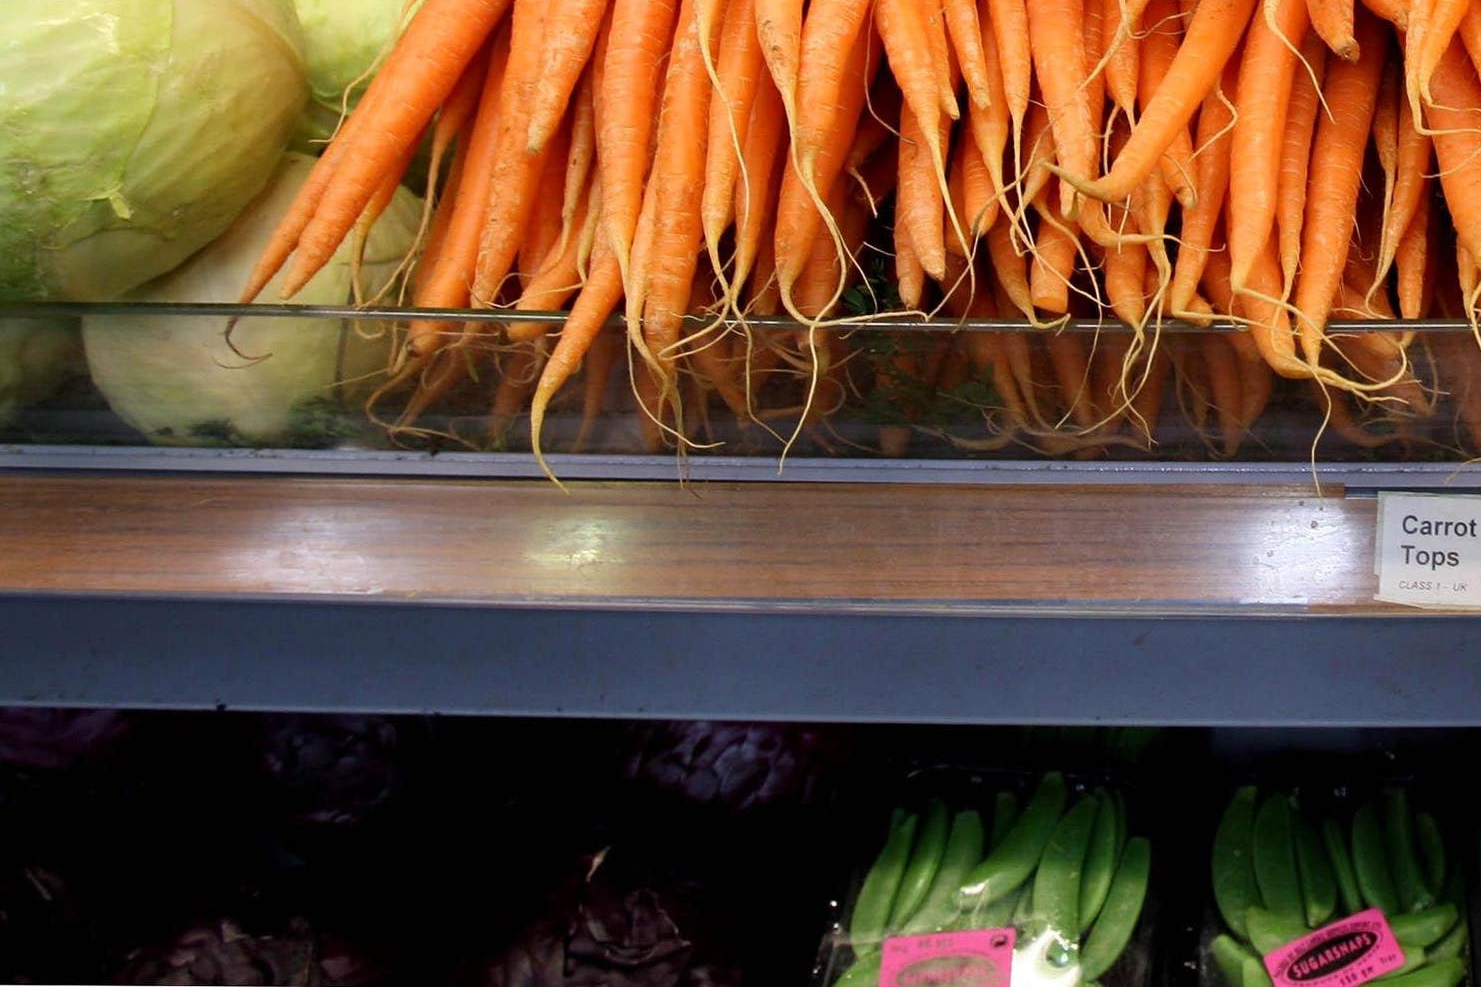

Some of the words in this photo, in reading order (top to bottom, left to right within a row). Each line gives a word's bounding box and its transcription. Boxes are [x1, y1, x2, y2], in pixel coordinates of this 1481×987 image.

[1402, 515, 1477, 538] Carrot
[1400, 544, 1460, 570] Tops
[1399, 580, 1433, 591] CLASS
[1453, 582, 1468, 592] UK
[1292, 932, 1373, 978] SUGARSNAPS
